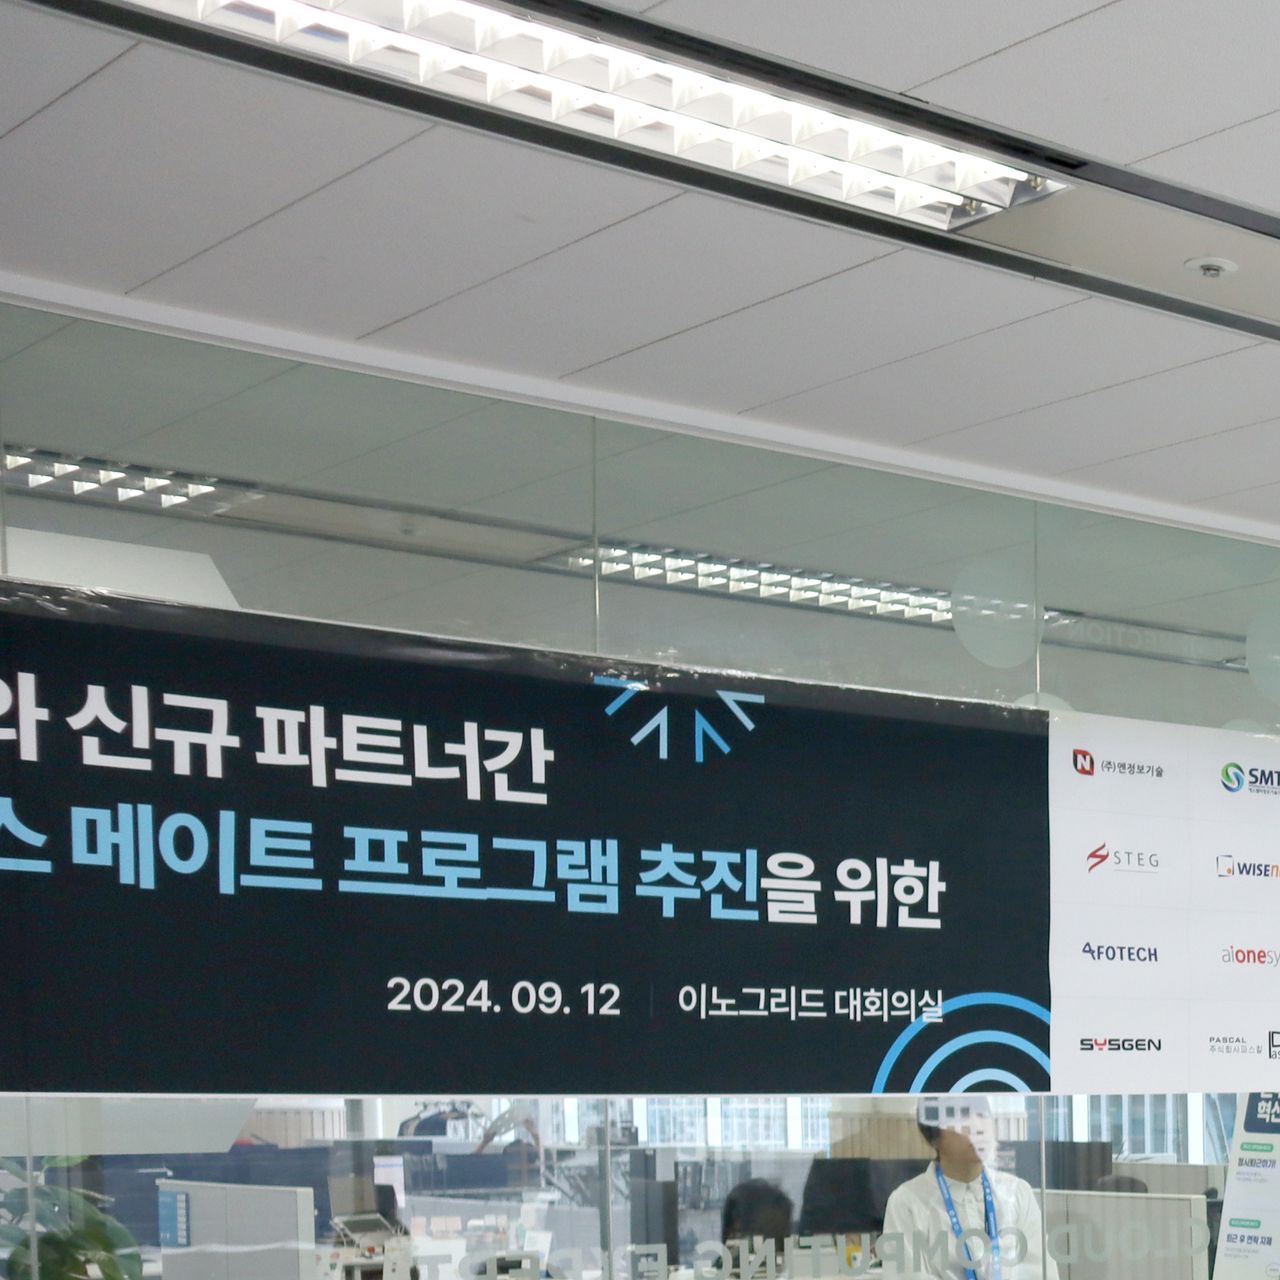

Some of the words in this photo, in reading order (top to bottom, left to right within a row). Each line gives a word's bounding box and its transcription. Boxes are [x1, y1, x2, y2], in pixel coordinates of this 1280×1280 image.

[67, 683, 240, 778] 신규
[255, 704, 554, 804] 파트너간
[1101, 760, 1164, 777] (주)엔정보기술
[70, 803, 322, 895] 메이트
[338, 826, 619, 914] 프로그램
[635, 843, 821, 924] 추진을
[834, 857, 946, 928] 위한
[1113, 851, 1159, 867] STEG
[386, 977, 501, 1014] 2024.
[511, 981, 571, 1014] 09.
[579, 984, 621, 1015] 12
[678, 983, 826, 1020] 이노그리드
[835, 987, 944, 1023] 대회의실
[1080, 1039, 1161, 1051] SYSGEN
